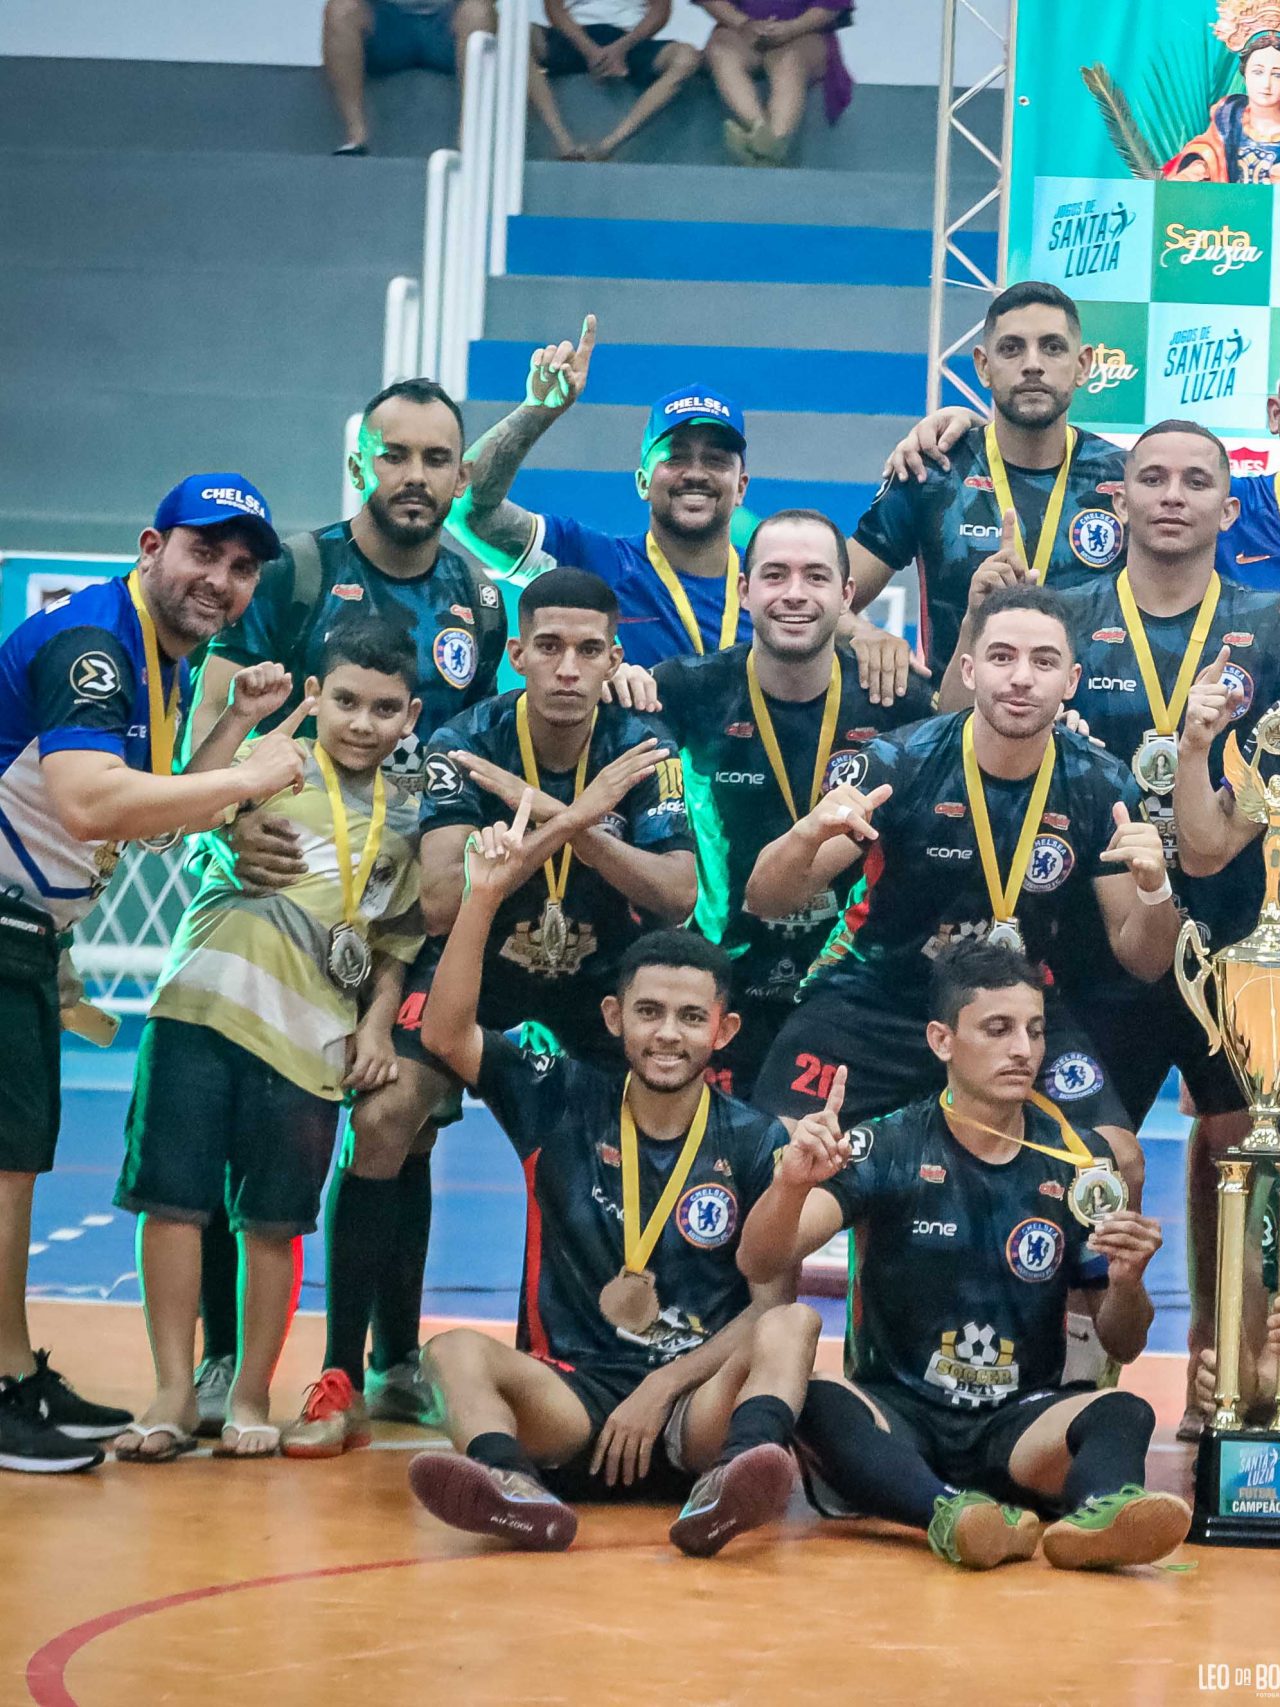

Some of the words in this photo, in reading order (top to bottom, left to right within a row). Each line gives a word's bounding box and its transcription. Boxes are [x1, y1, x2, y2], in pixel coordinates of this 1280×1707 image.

[1048, 212, 1109, 251] SANTA
[1165, 223, 1252, 250] Santa
[1064, 240, 1121, 279] LUZIA
[1160, 229, 1264, 276] Luzia
[1164, 339, 1225, 378] SANTA
[1180, 367, 1236, 404] LUZIA
[665, 397, 730, 417] CHELSEA
[201, 488, 265, 518] CHELSEA
[1080, 512, 1115, 527] CHELSEA
[1034, 838, 1067, 855] HELSEA
[689, 1188, 730, 1204] CHELSEA
[1022, 1222, 1058, 1238] CHELSEA
[934, 1358, 1014, 1386] SOCCER
[1238, 1453, 1269, 1474] SANTA
[1247, 1467, 1275, 1487] LUZIA
